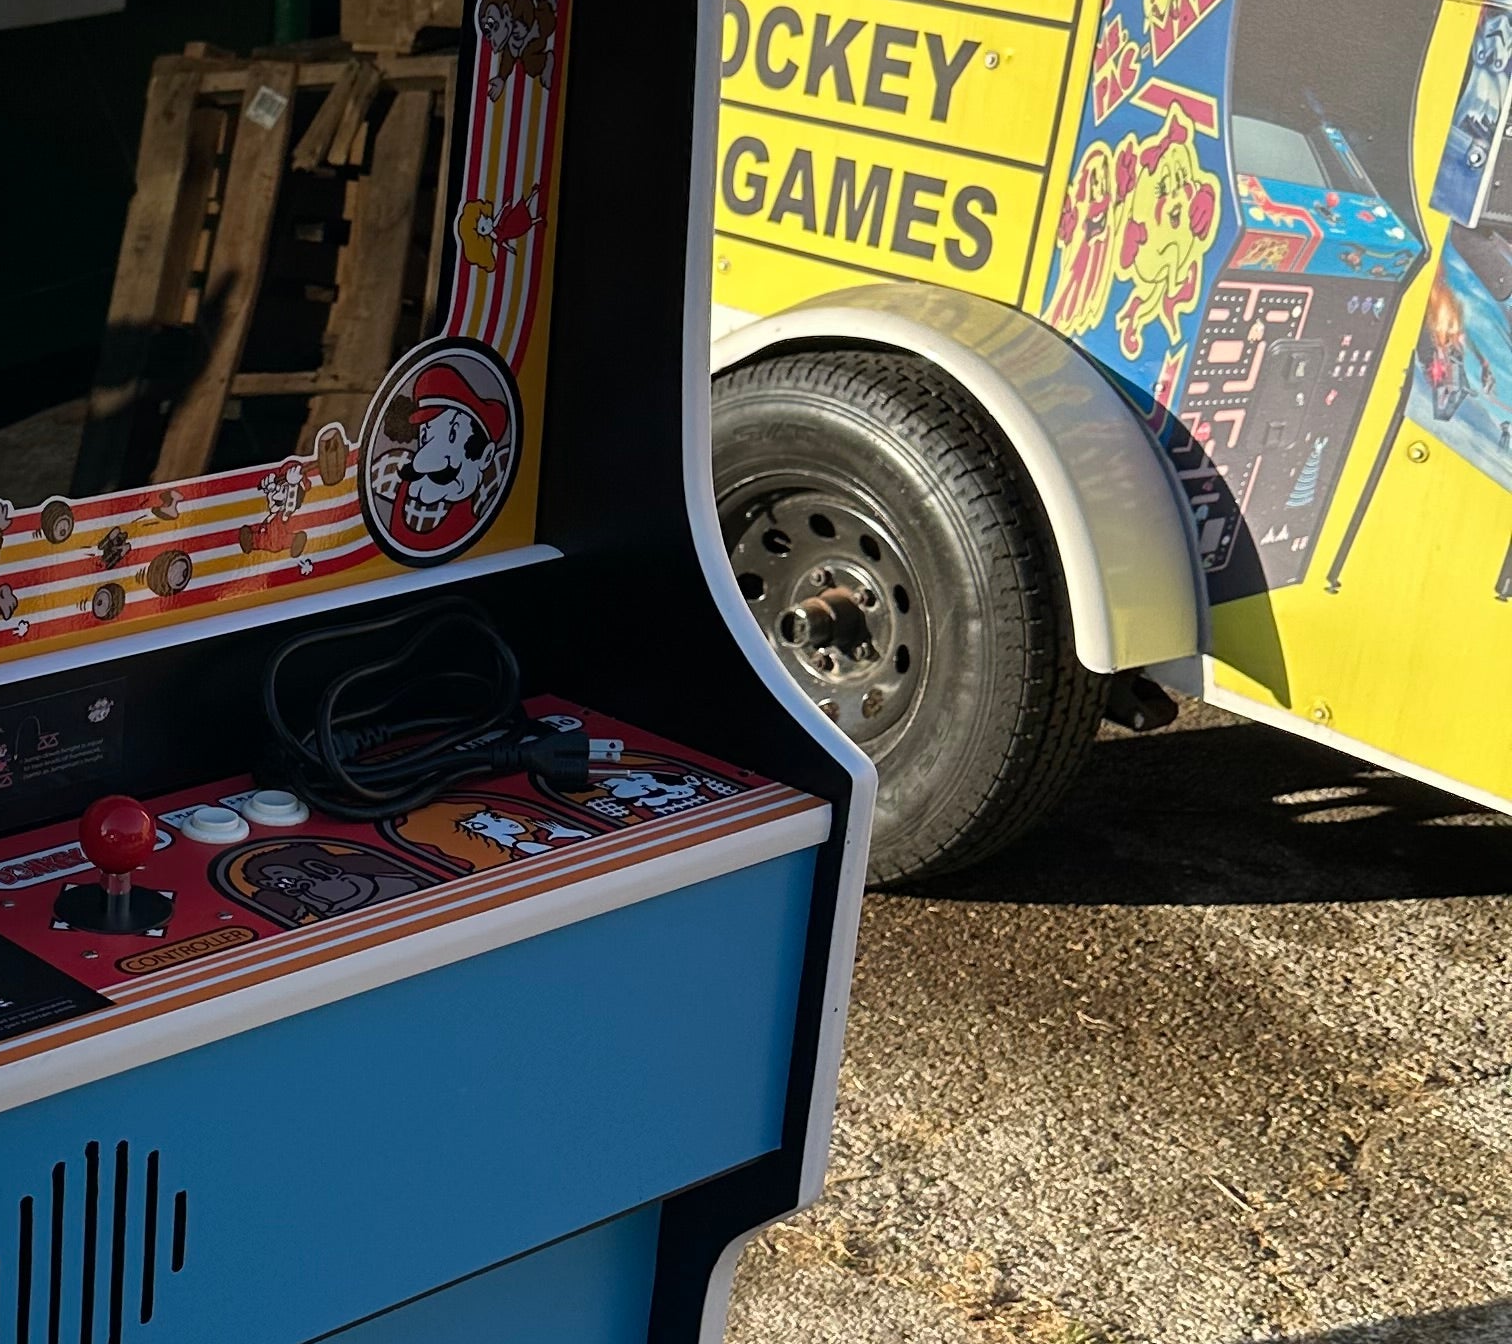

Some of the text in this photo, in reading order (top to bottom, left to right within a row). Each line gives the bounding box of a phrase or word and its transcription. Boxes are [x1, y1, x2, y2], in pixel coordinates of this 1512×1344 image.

[719, 4, 982, 123] OCKEY
[719, 134, 999, 272] GAMES
[127, 926, 250, 971] CONTROLLER
